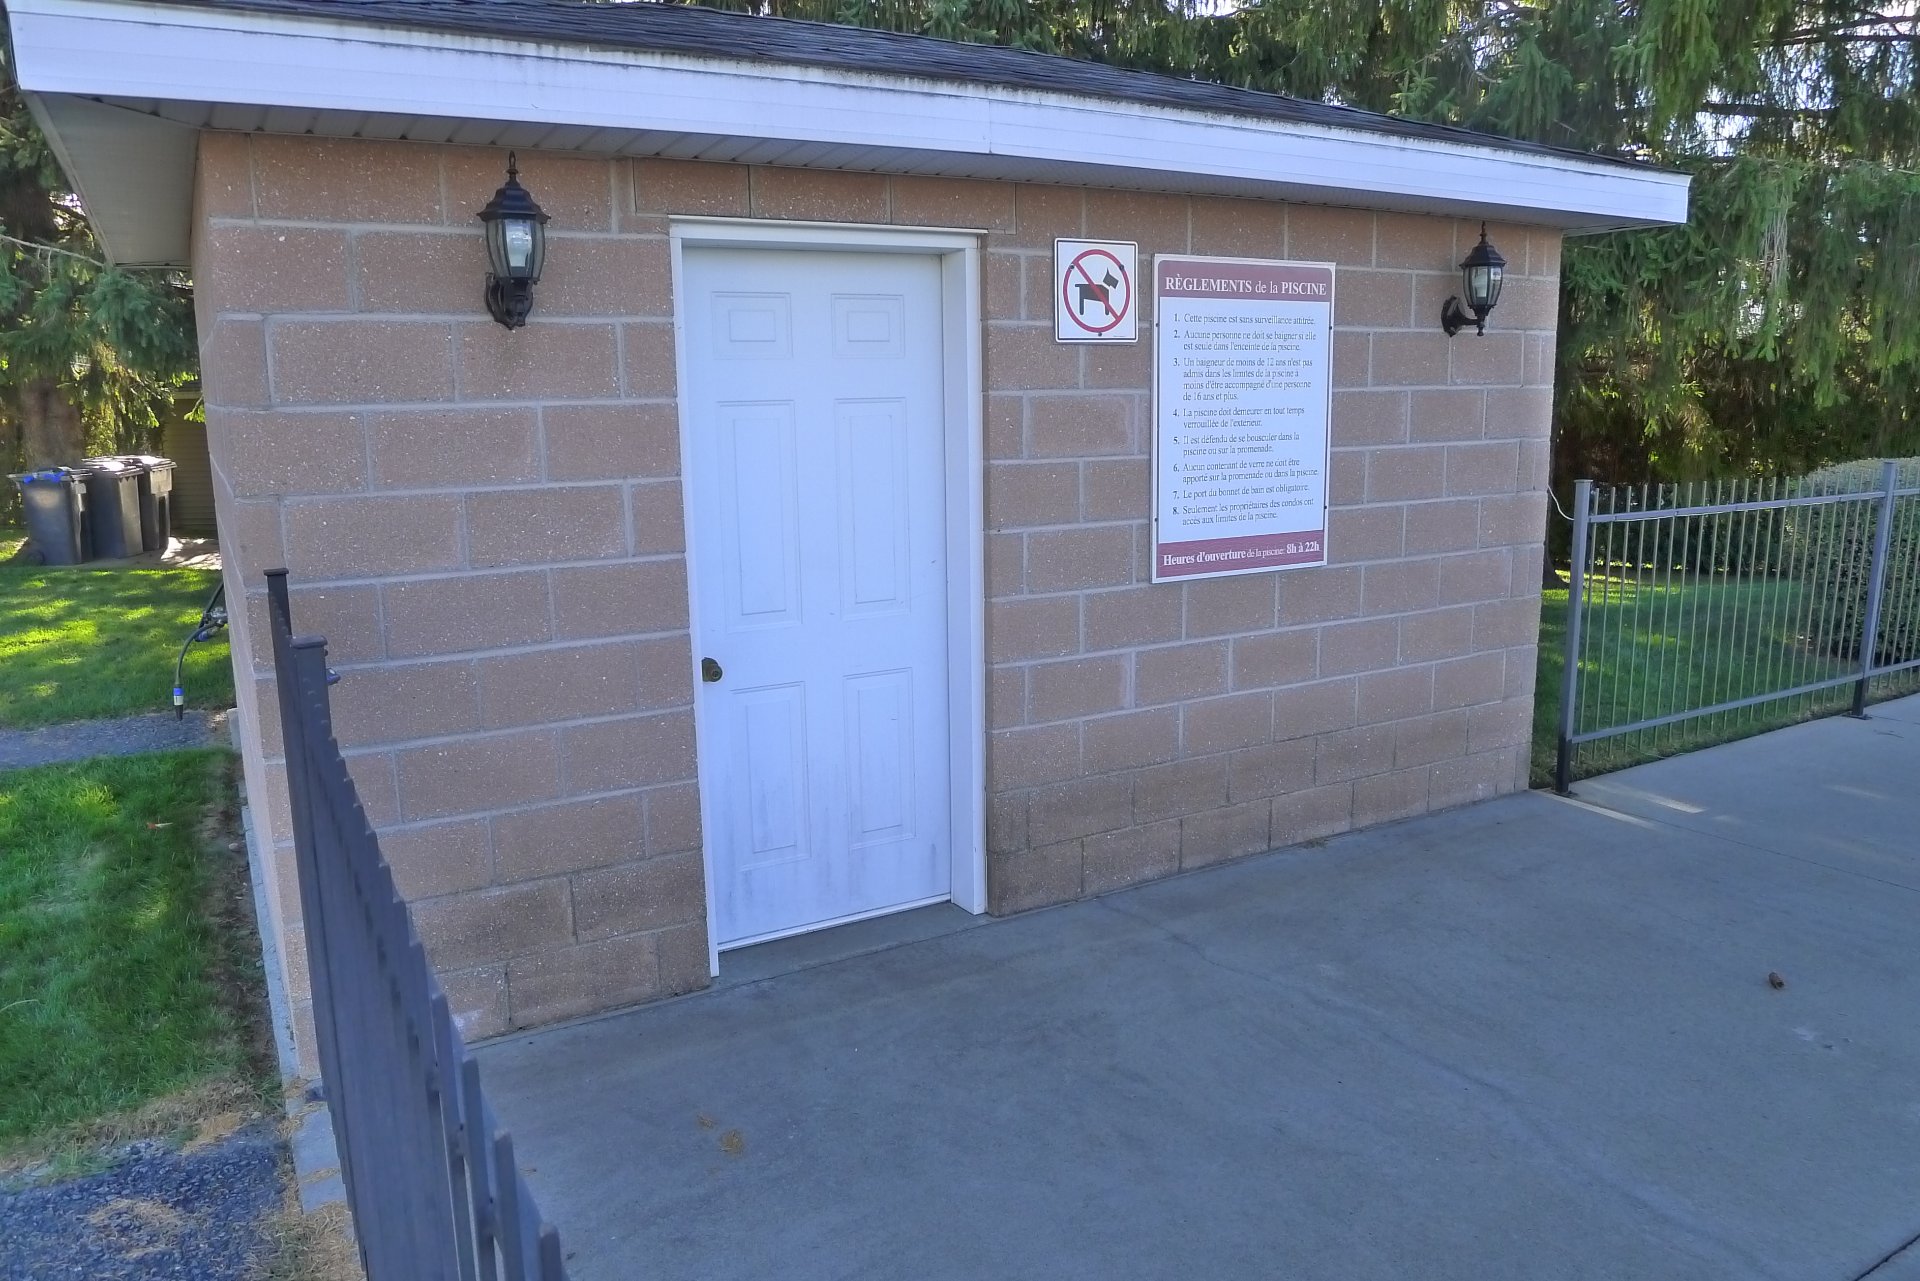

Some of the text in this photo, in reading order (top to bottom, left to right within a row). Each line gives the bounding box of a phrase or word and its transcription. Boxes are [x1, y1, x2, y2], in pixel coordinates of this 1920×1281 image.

[1165, 274, 1327, 295] RÈGLEMENTS de la PISCINE
[1184, 313, 1202, 322] Cette
[1204, 314, 1226, 324] piscine
[1228, 315, 1238, 323] est
[1254, 316, 1292, 324] surveillance
[1184, 330, 1210, 338] Aucune
[1212, 332, 1242, 341] personne
[1252, 330, 1264, 340] doit
[1274, 331, 1298, 342] baigner
[1305, 331, 1316, 340] elle
[1194, 342, 1212, 350] seule
[1214, 342, 1228, 350] dans
[1262, 342, 1270, 350] de
[1184, 358, 1194, 366] Un
[1196, 357, 1224, 368] baigneur
[1227, 357, 1234, 366] de
[1236, 358, 1256, 366] moins
[1257, 357, 1264, 366] de
[1267, 358, 1274, 366] 12
[1288, 358, 1301, 366] n'est
[1303, 360, 1312, 368] pas
[1184, 368, 1204, 378] admis
[1205, 368, 1220, 378] dans
[1222, 368, 1231, 378] les
[1233, 369, 1254, 378] limites
[1256, 369, 1264, 378] de
[1272, 369, 1294, 380] piscine
[1184, 380, 1204, 389] moins
[1225, 380, 1264, 390] accompagné
[1284, 381, 1312, 390] personne
[1183, 392, 1191, 400] de
[1194, 392, 1202, 400] 16
[1224, 392, 1238, 402] plus.
[1184, 408, 1192, 416] La
[1194, 408, 1218, 419] piscine
[1219, 407, 1231, 416] doit
[1287, 407, 1304, 416] temps
[1220, 420, 1228, 428] de
[1229, 434, 1237, 442] de
[1247, 433, 1277, 442] bousculer
[1278, 432, 1292, 440] dans
[1184, 448, 1206, 458] piscine
[1184, 463, 1204, 471] Aucun
[1207, 461, 1238, 470] contenant
[1275, 458, 1287, 466] doit
[1288, 458, 1300, 466] être
[1183, 472, 1208, 484] apporté
[1229, 470, 1263, 482] promenade
[1274, 469, 1288, 478] dans
[1184, 490, 1192, 498] Le
[1194, 490, 1206, 500] port
[1209, 488, 1217, 496] du
[1219, 488, 1240, 496] bonnet
[1242, 486, 1250, 494] de
[1251, 486, 1264, 494] bain
[1183, 504, 1218, 514] Seulement
[1219, 503, 1228, 512] les
[1230, 501, 1268, 513] propriétaires
[1270, 500, 1280, 508] des
[1282, 498, 1302, 507] condos
[1216, 514, 1237, 522] limites
[1164, 554, 1194, 566] Heures
[1197, 549, 1246, 562] d'ouverture
[1247, 548, 1255, 558] de
[1286, 543, 1297, 554] 8h
[1305, 541, 1320, 552] 22h
